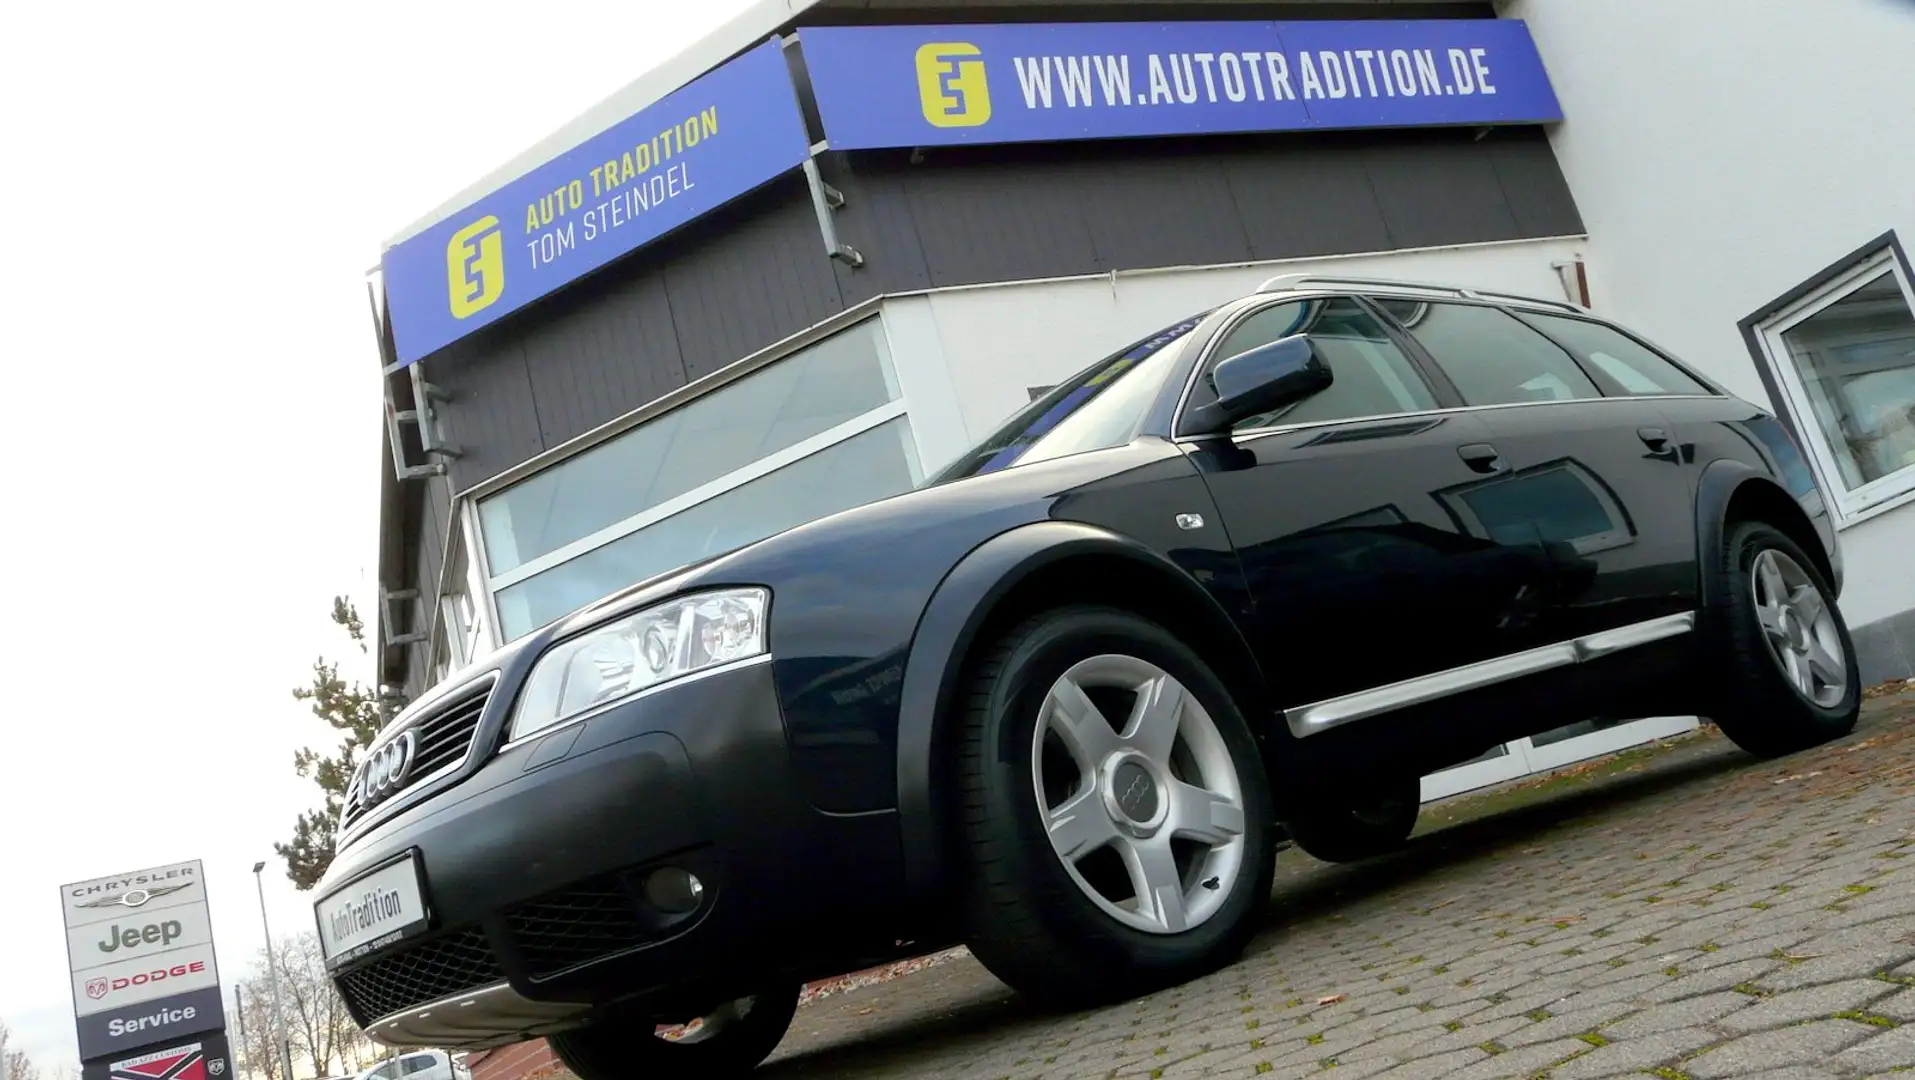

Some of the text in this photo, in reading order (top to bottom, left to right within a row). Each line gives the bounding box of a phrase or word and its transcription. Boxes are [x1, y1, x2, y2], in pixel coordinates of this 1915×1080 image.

[1014, 48, 1497, 109] WWW.AUTOTRADITION.DE
[526, 106, 719, 234] AUTO TRADITION
[527, 163, 695, 270] TOM STEINDEL
[72, 867, 194, 897] CHRYSLER
[98, 919, 182, 953] Jeep
[330, 887, 402, 943] AutoTradition
[112, 961, 205, 991] DODGE
[108, 1006, 196, 1037] Service
